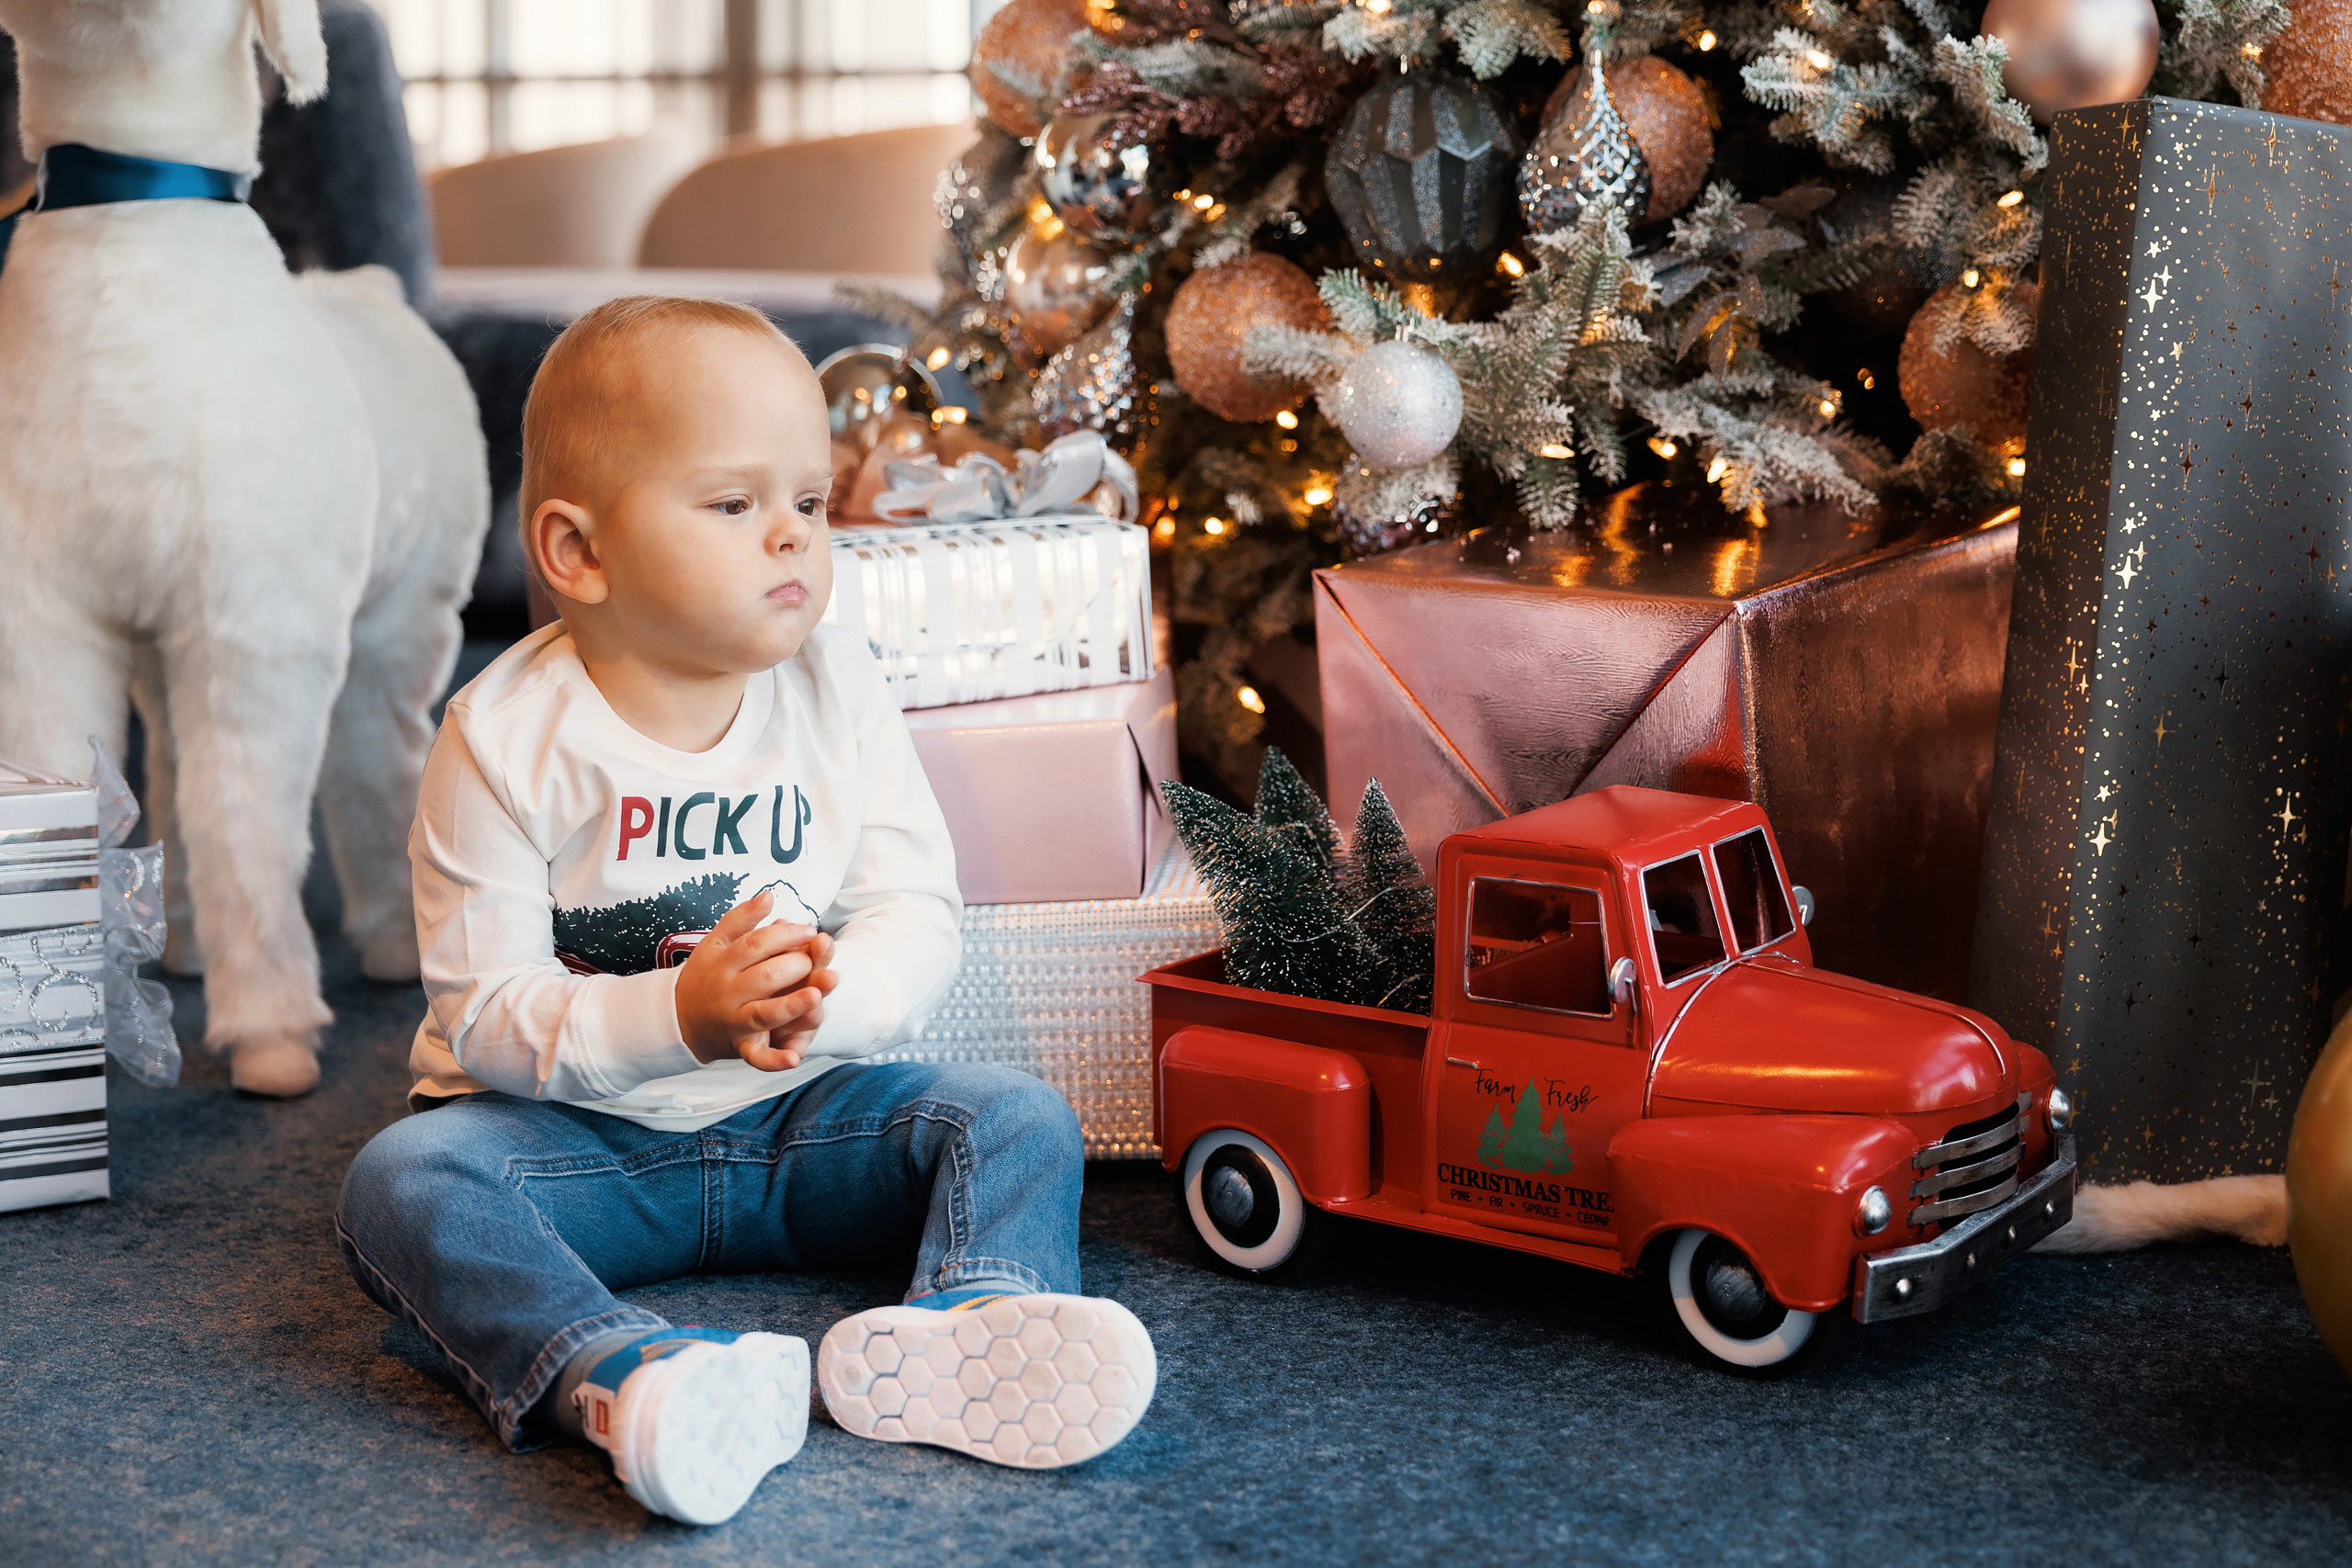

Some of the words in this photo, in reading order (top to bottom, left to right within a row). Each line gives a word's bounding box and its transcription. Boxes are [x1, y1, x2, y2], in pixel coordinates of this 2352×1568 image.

[616, 791, 759, 862] PICK
[1475, 1068, 1515, 1104] Farm
[1544, 1077, 1600, 1113] Fresh
[1437, 1162, 1561, 1203] CHRISTMAS
[1564, 1186, 1614, 1213] TRE
[1450, 1189, 1472, 1202] PINE
[1488, 1196, 1504, 1208] FIR
[1521, 1201, 1560, 1218] SPRUCE
[1577, 1211, 1610, 1227] CEDAR
